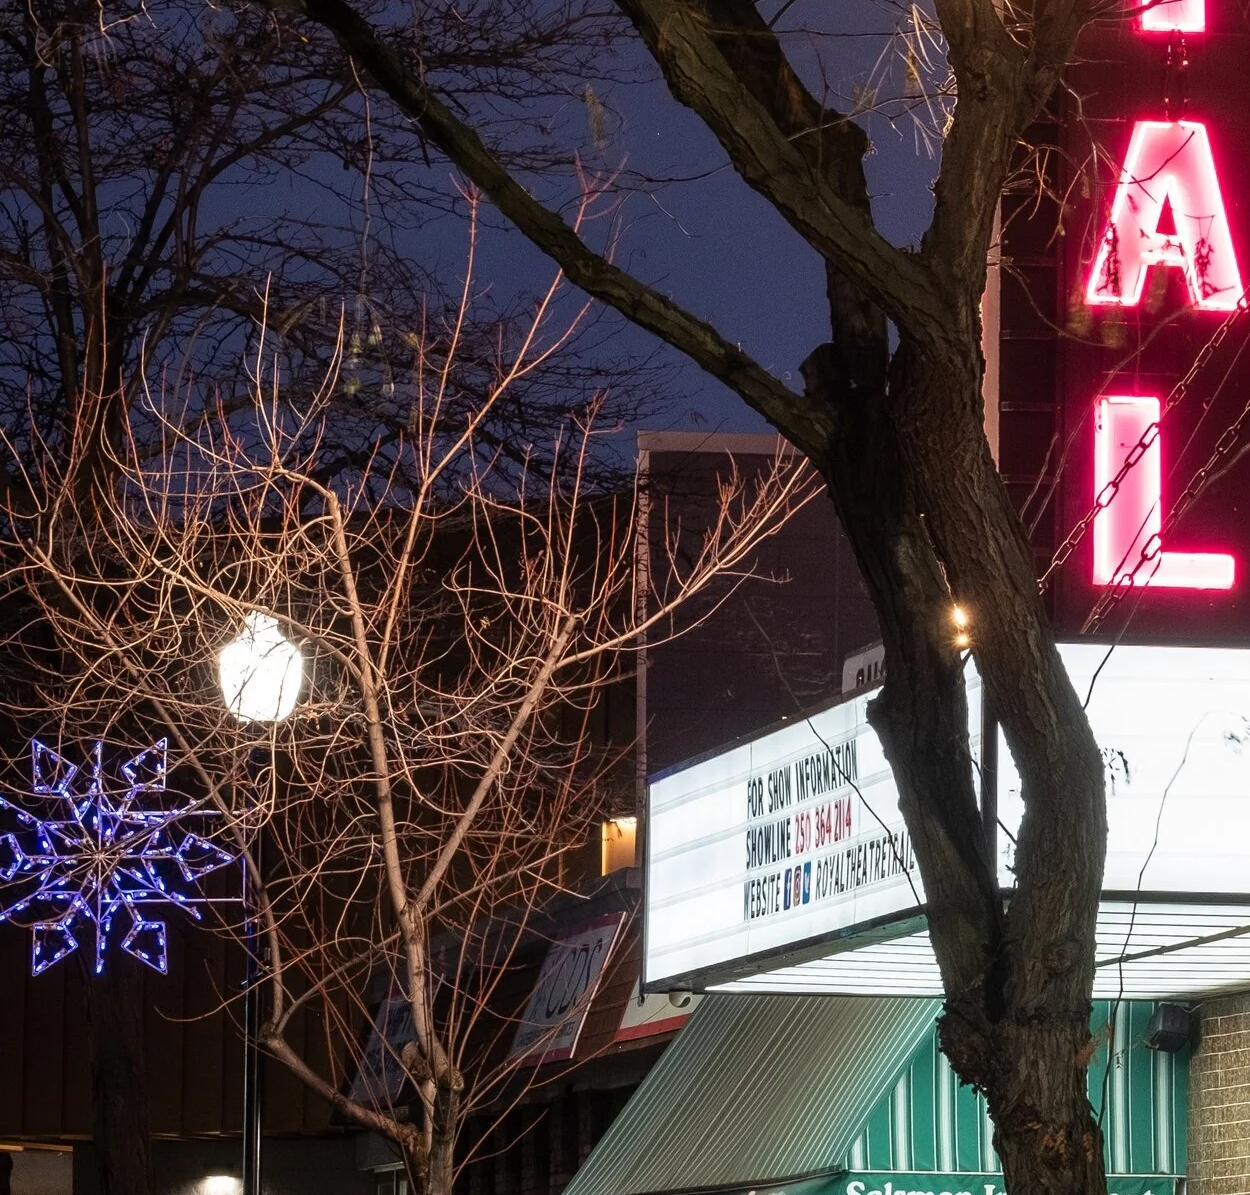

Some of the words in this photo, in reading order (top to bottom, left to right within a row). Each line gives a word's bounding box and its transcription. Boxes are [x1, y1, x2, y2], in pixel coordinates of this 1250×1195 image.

[747, 777, 764, 819] FOR
[768, 765, 791, 812] SHOW
[795, 740, 858, 803] INFORMATION
[746, 818, 791, 870] SHOWLINE
[795, 812, 811, 854] 250
[815, 803, 832, 848] 364
[834, 796, 852, 842] 2114
[744, 873, 781, 921] WEBSITE
